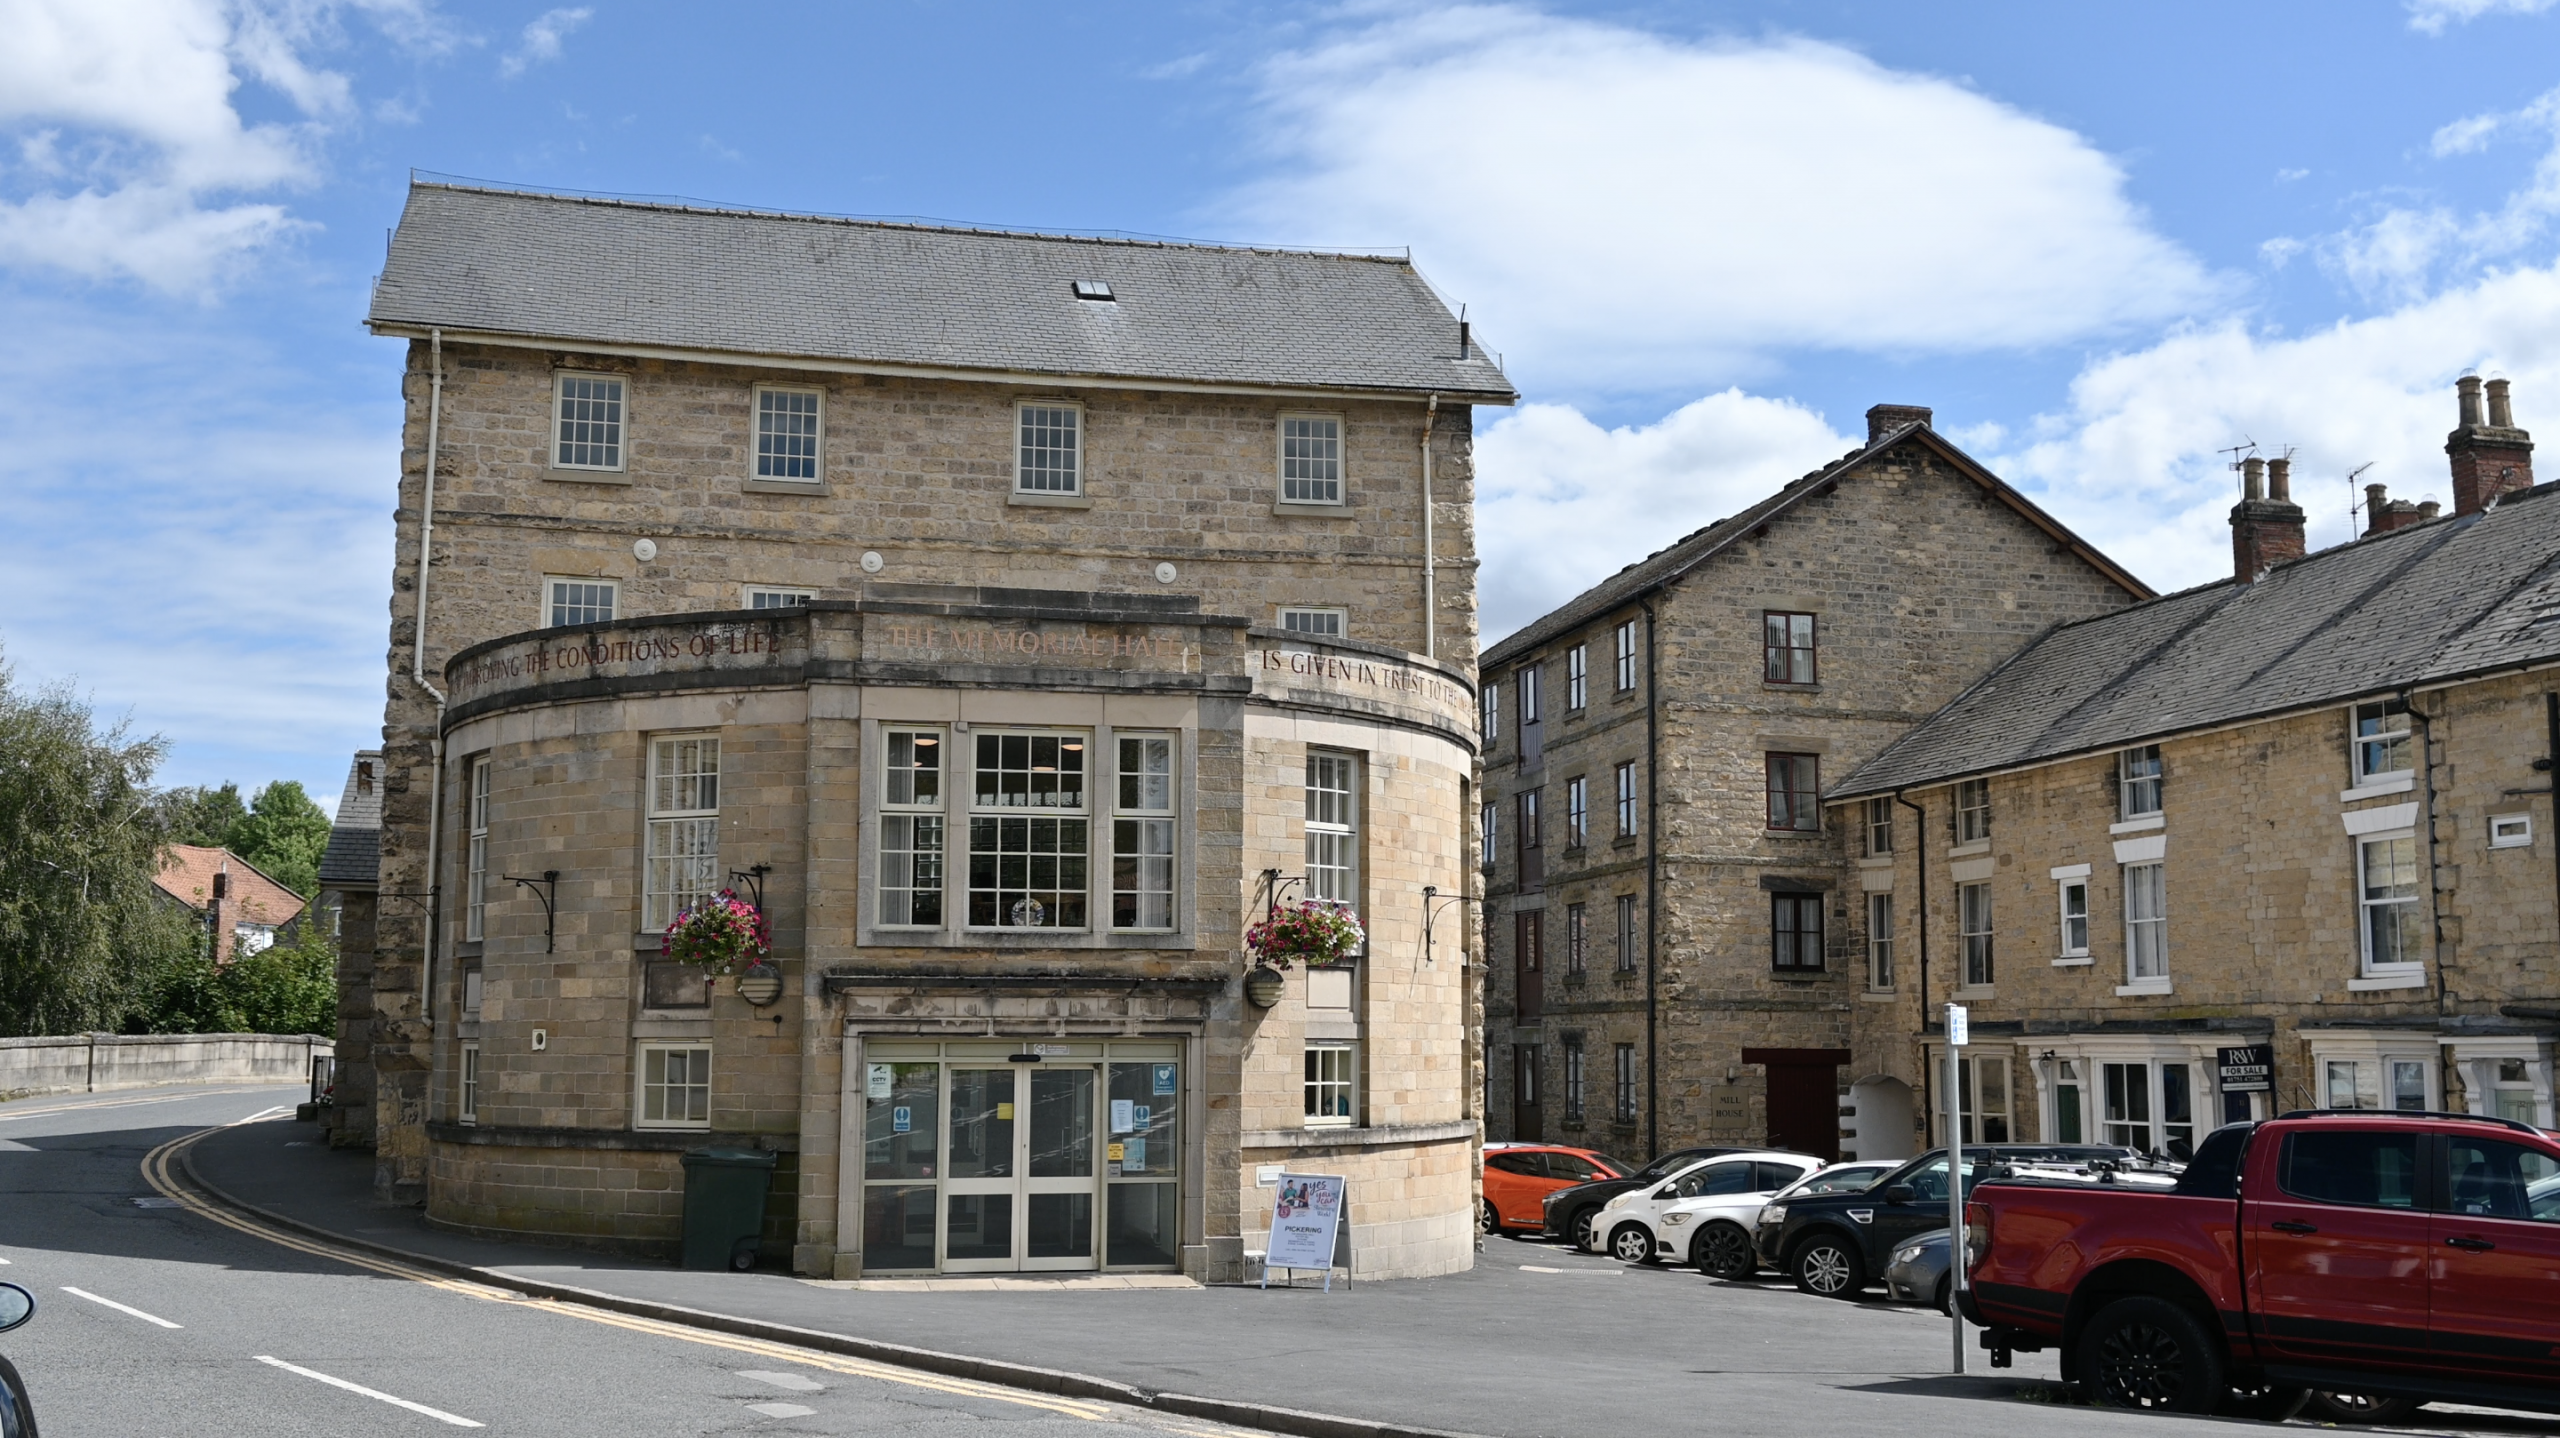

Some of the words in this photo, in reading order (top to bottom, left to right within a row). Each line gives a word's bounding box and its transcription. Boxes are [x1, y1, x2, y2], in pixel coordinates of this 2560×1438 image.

[889, 627, 937, 650] THE
[950, 628, 1104, 657] MEMORIAL
[1113, 634, 1178, 658] HALL
[525, 650, 550, 674] THE
[556, 635, 680, 668] CONDITIONS
[688, 633, 721, 657] OF
[729, 631, 780, 655] LIFE
[1262, 649, 1281, 671] IS
[1291, 653, 1352, 681] GIVEN
[1358, 662, 1376, 686] IN
[1381, 667, 1426, 696] TRUST
[1428, 680, 1441, 701] TO
[1443, 684, 1457, 708] THE
[2228, 1048, 2257, 1065] R&W
[2226, 1067, 2242, 1075] FOR
[2244, 1066, 2263, 1075] SALE
[1720, 1096, 1741, 1104] MILL
[1716, 1109, 1744, 1118] HOUSE
[1309, 1180, 1327, 1196] yes
[1316, 1191, 1331, 1203] you
[1320, 1197, 1336, 1205] can
[1284, 1225, 1323, 1234] PICKERING
